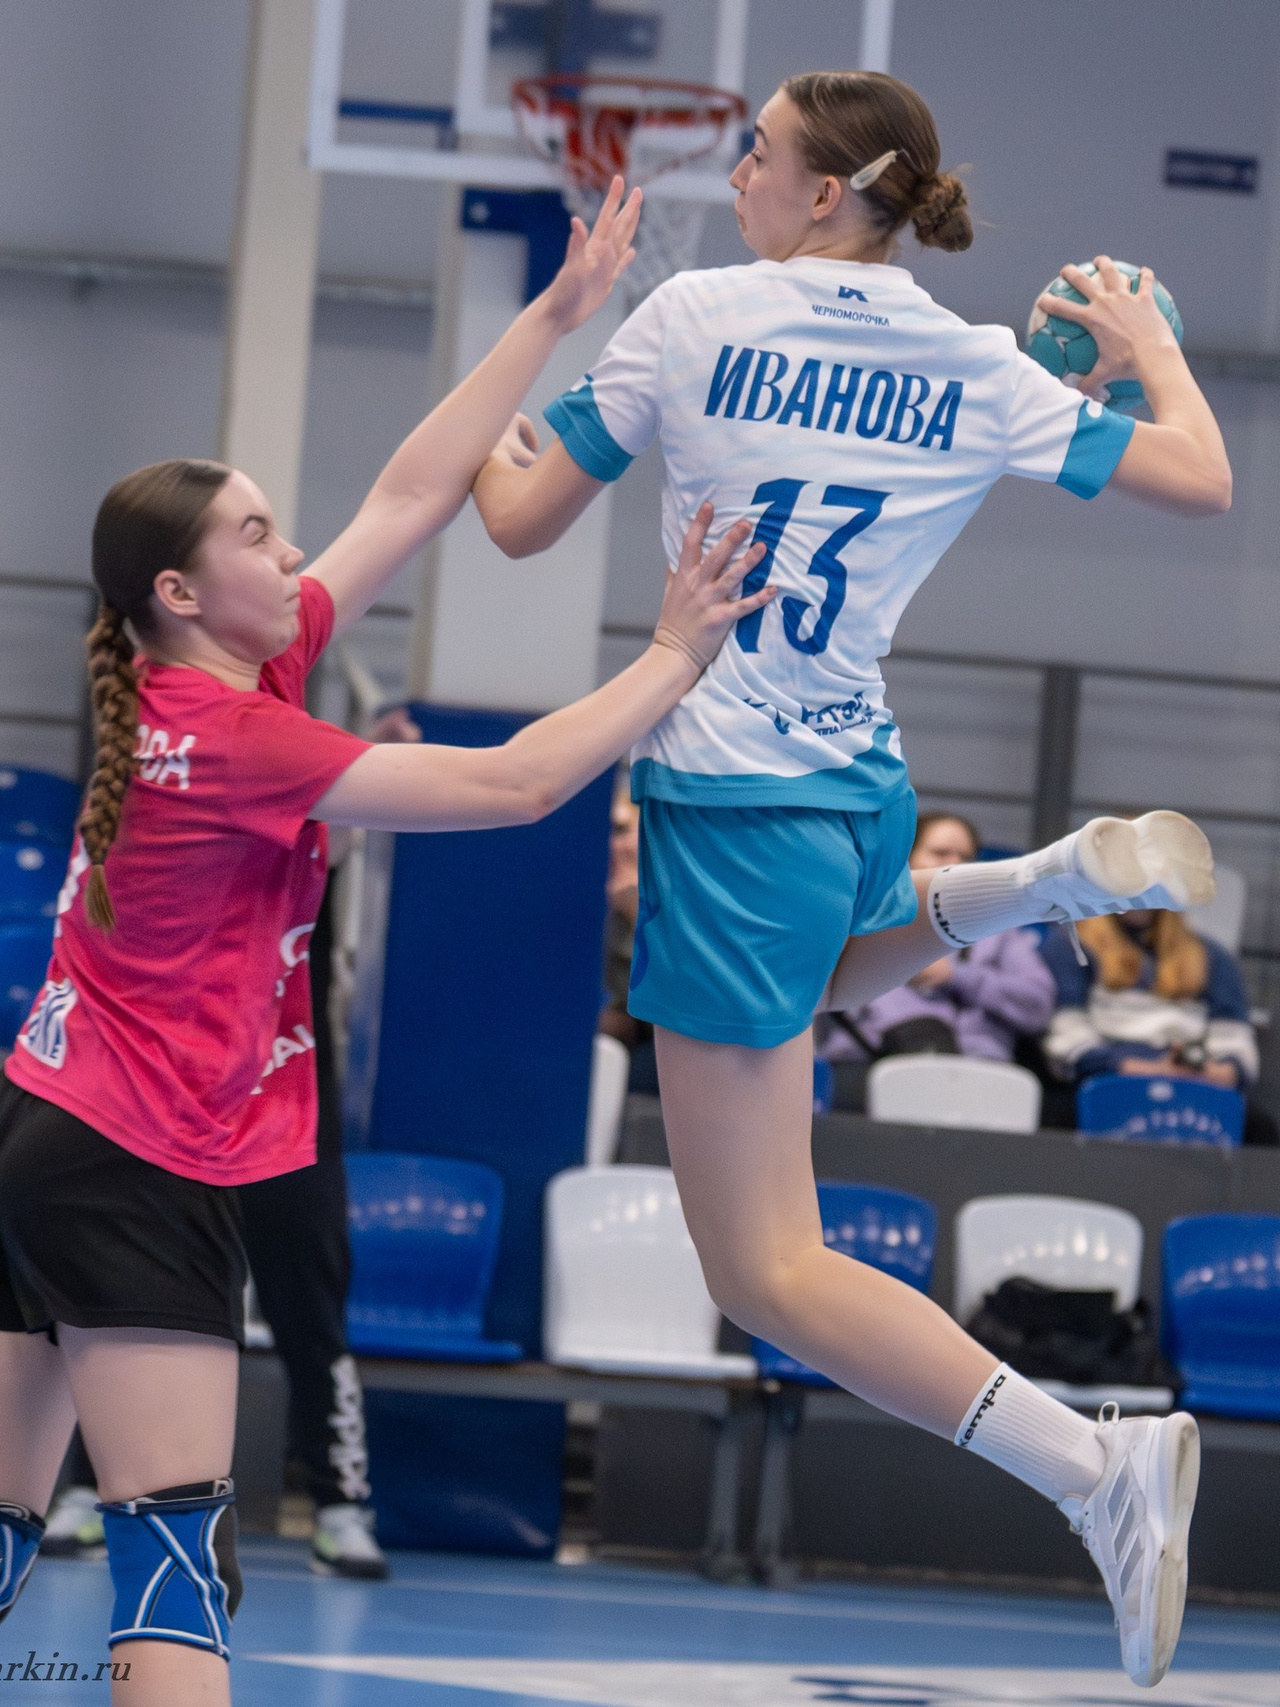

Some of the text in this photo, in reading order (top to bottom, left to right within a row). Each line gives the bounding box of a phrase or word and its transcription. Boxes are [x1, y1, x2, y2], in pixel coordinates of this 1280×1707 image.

[811, 304, 890, 327] ЧЕРНОМОРОЧКА
[703, 344, 965, 452] ИВАНОВА
[735, 477, 895, 656] 13
